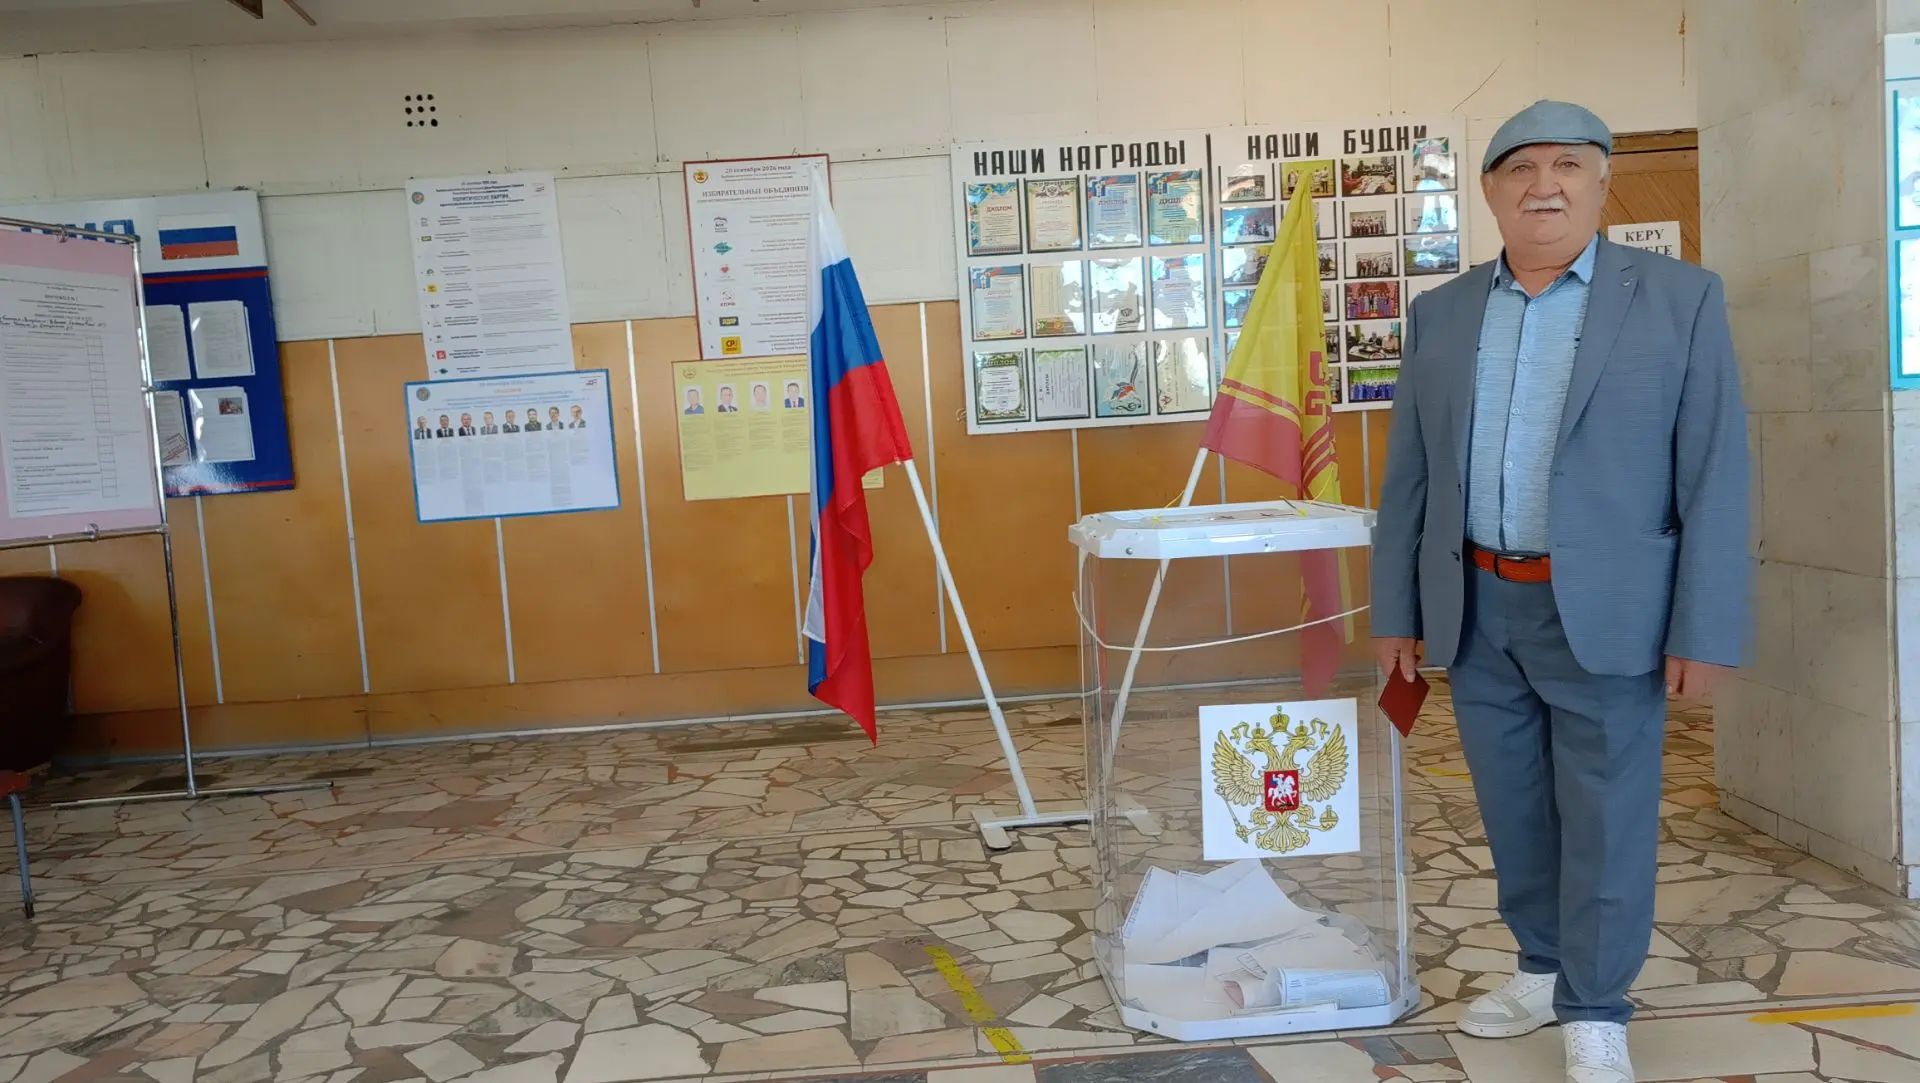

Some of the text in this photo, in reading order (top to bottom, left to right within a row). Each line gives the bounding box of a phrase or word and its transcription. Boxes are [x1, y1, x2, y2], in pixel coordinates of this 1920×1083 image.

[974, 140, 1186, 176] НАШИ НАГРАДЫ
[1247, 125, 1427, 160] НАШИ БУДНИ
[1625, 229, 1664, 242] КЕРУ
